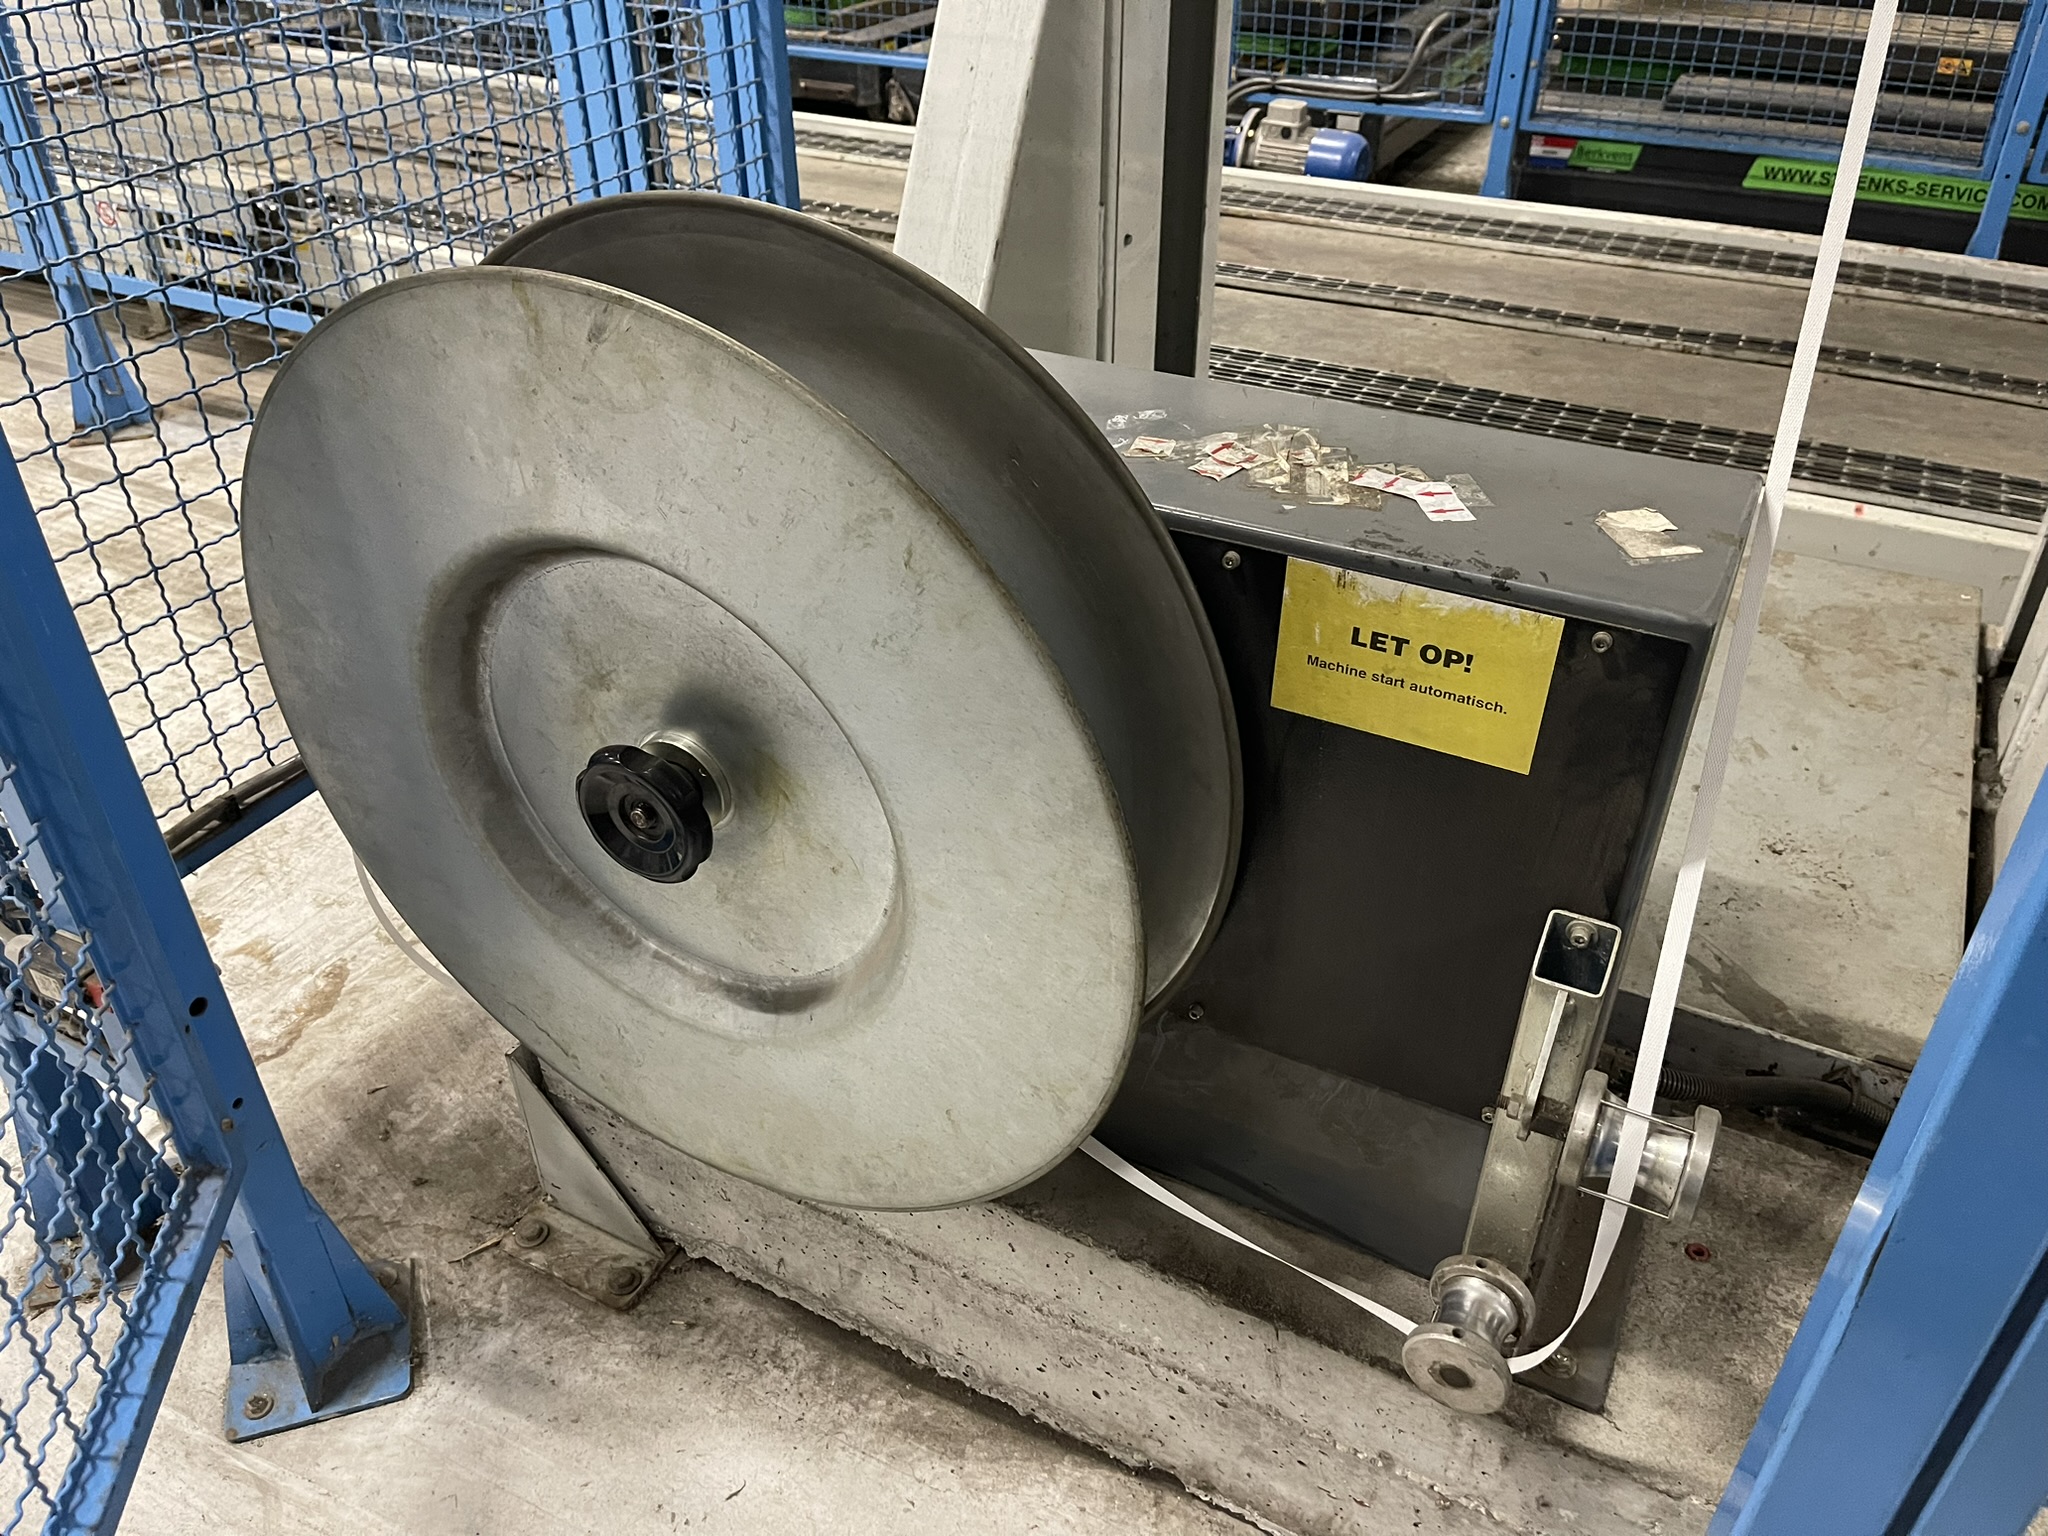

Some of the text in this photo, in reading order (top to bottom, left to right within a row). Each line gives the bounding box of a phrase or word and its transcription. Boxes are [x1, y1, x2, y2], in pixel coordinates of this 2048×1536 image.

[1350, 626, 1474, 673] LET OP!
[1306, 654, 1507, 714] Machine start automatisch.
